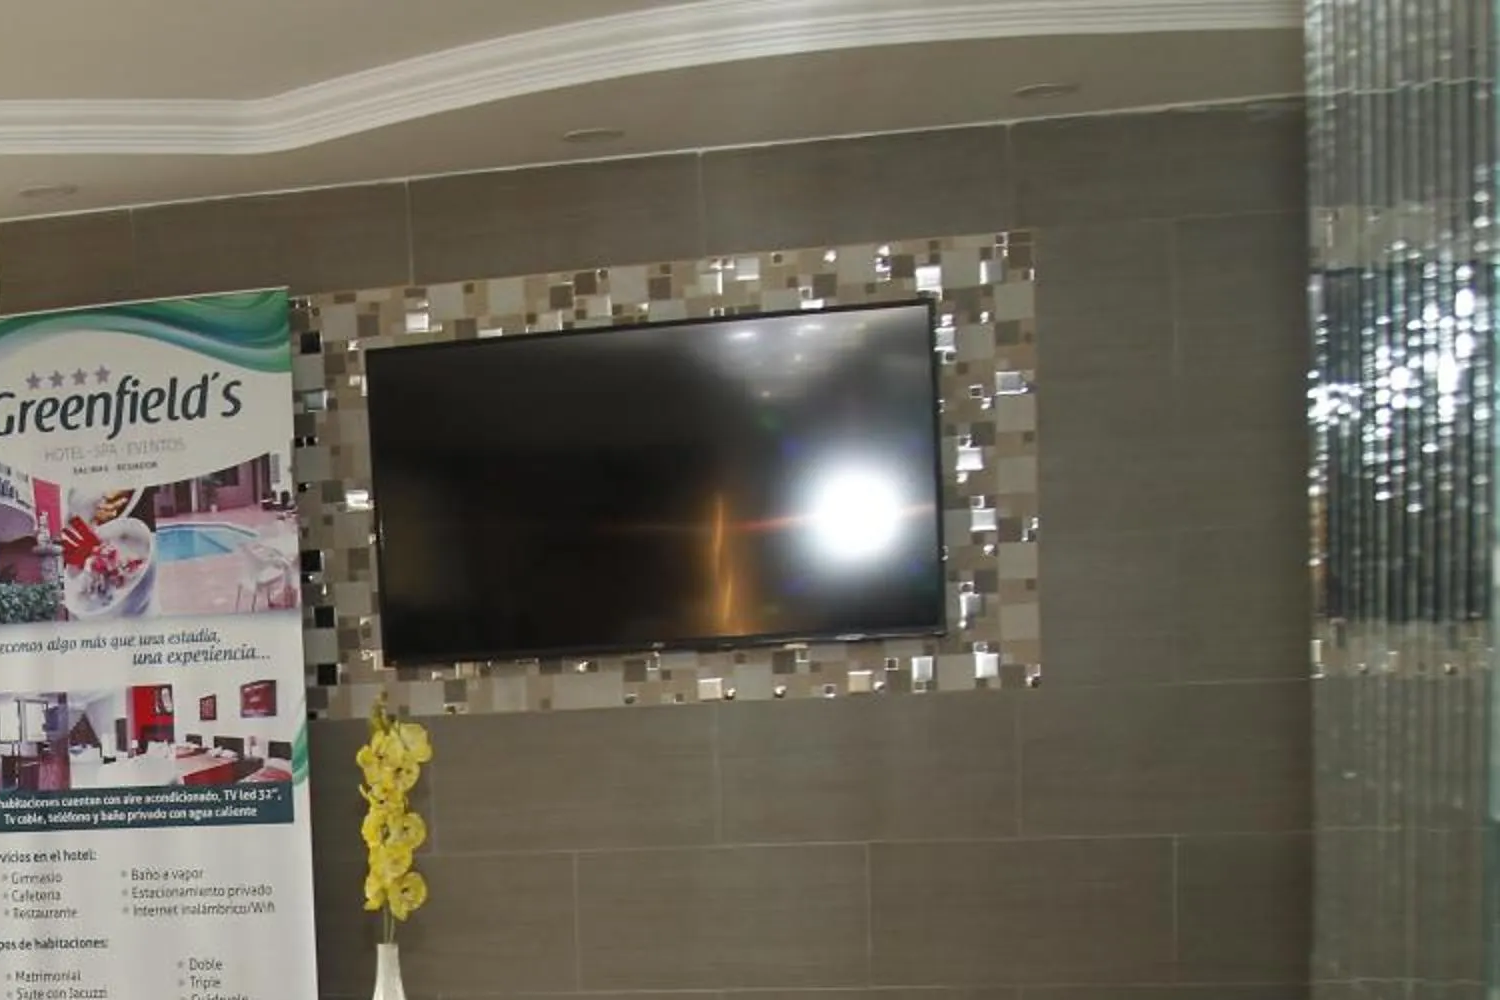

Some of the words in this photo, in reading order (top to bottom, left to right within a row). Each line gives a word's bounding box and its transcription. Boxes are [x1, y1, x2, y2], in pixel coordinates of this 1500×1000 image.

[117, 461, 159, 472] ECUADOR
[47, 635, 77, 654] algo
[80, 636, 107, 649] más
[109, 636, 135, 651] que
[138, 634, 165, 647] una
[132, 651, 163, 667] una
[61, 795, 101, 807] cuentan
[104, 796, 121, 805] con
[123, 793, 143, 805] aire
[224, 790, 237, 801] TV
[239, 788, 257, 801] led
[17, 812, 47, 825] cable,
[48, 809, 91, 824] teléfono
[101, 809, 126, 821] baño
[127, 807, 167, 822] privado
[169, 808, 187, 819] con
[189, 807, 213, 820] agua
[215, 804, 258, 817] caliente
[34, 854, 48, 862] en
[50, 850, 61, 862] el
[11, 871, 63, 884] Gimnasio
[131, 867, 160, 881] Baño
[172, 867, 203, 881] vapor
[131, 885, 225, 899] Estacionamiento
[228, 883, 273, 898] privado
[133, 903, 179, 917] Internet
[19, 938, 32, 950] de
[189, 957, 223, 971] Doble
[15, 970, 81, 983] Matrimonial
[190, 975, 221, 990] Triple
[47, 988, 67, 1000] con
